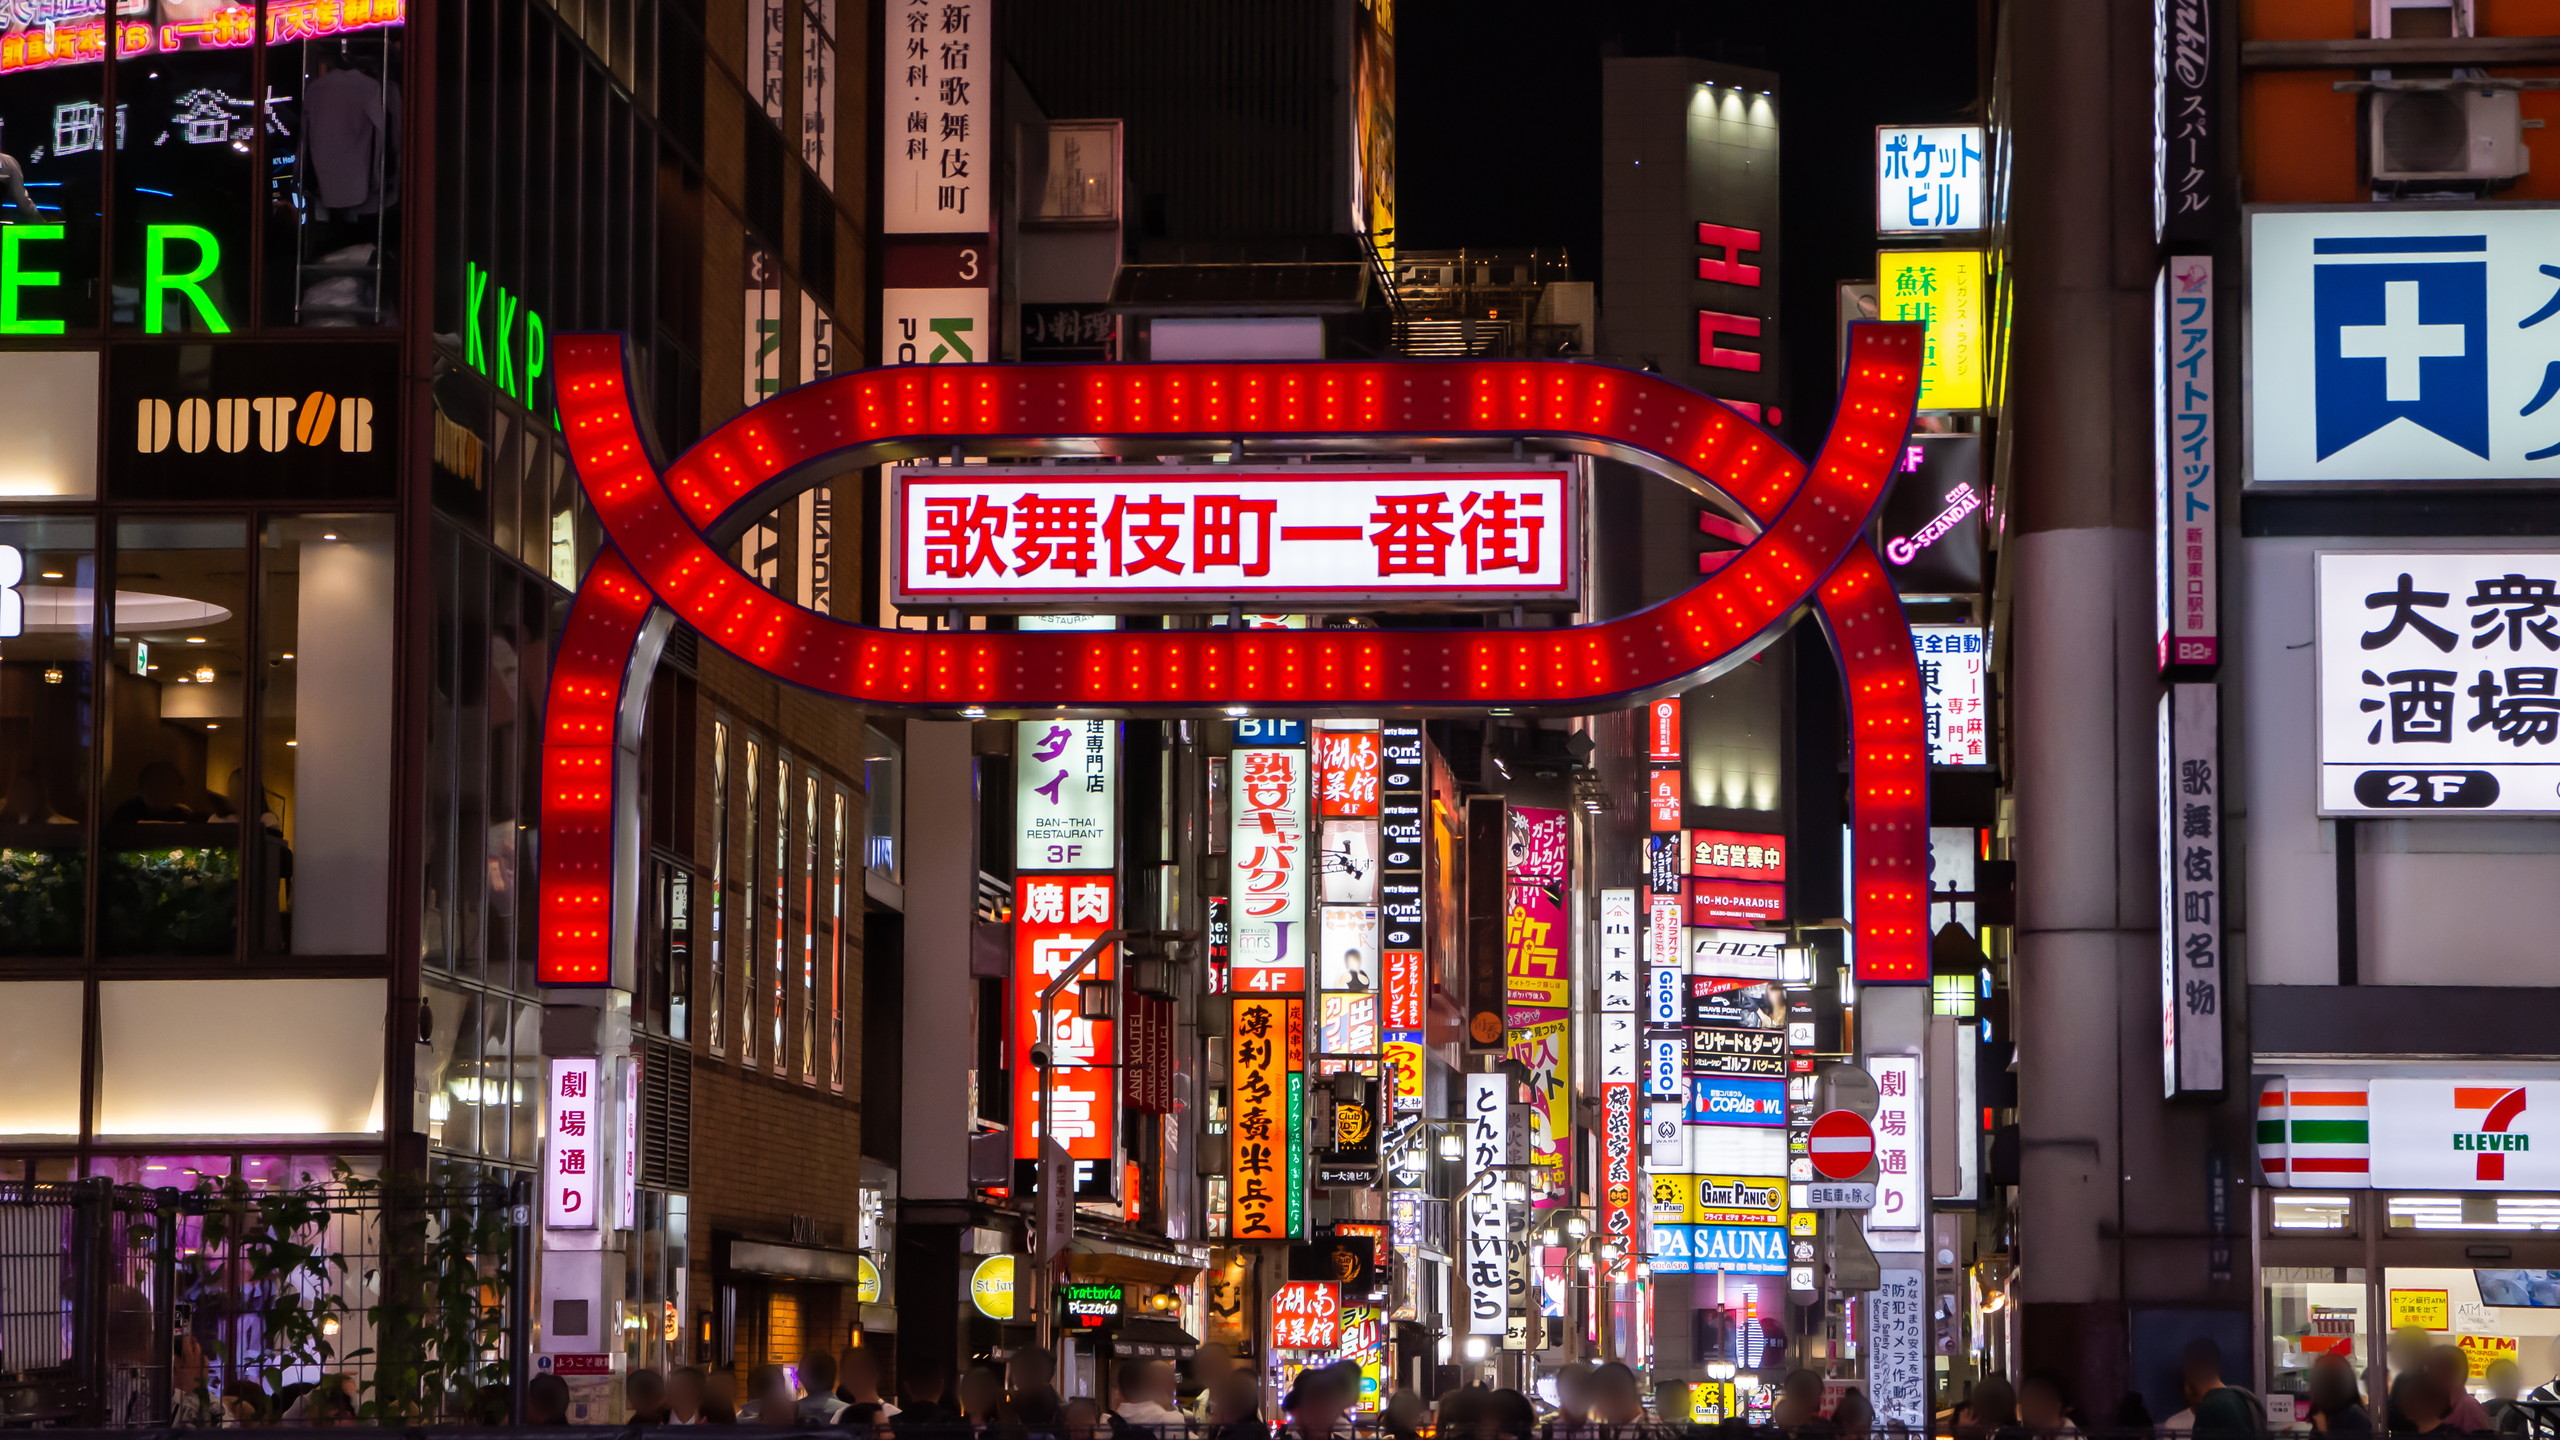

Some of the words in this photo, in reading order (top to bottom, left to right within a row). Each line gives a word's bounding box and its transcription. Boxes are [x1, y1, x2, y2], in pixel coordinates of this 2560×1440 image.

[905, 0, 929, 161] 容外科・歯科
[938, 2, 971, 215] 新宿歌舞伎町
[1884, 132, 1982, 181] ポケット
[2177, 94, 2211, 215] スパークル
[1908, 184, 1960, 228] ビル
[958, 249, 979, 280] 3
[1956, 264, 1968, 376] エレガンス・ラウンジ
[137, 391, 373, 453] DOUTOR
[2175, 297, 2210, 522] ファイトフィット
[1945, 482, 1971, 503] CLUB
[924, 491, 1545, 579] 歌舞伎町一番街
[1886, 493, 1981, 566] G-SCANDAL
[2186, 528, 2204, 630] 新宿東口駅前
[2361, 573, 2560, 653] 大衆
[2179, 643, 2213, 660] B2F
[1966, 658, 1983, 756] リーチ麻雀
[2360, 666, 2560, 747] 酒場
[1032, 725, 1073, 805] タイ
[1323, 736, 1378, 771] 湖南
[1659, 783, 1679, 820] 白木屋
[2387, 775, 2467, 803] 2F
[1036, 818, 1096, 827] BAN-THAI
[1340, 803, 1360, 814] 4F
[1027, 829, 1104, 839] RESTAURANT
[1237, 752, 1301, 917] 熟女キャバクラ
[1047, 845, 1083, 863] 3F
[1695, 841, 1780, 870] 全店営業中
[1022, 883, 1110, 924] 焼肉
[1696, 895, 1780, 909] MO-MO-PARADISE
[2182, 759, 2216, 1016] 歌舞伎町名物
[1668, 916, 1678, 955] カラオケ
[1696, 941, 1778, 958] FACE
[1250, 969, 1287, 990] 4F
[1391, 954, 1405, 1028] リフレッシュ
[1659, 970, 1673, 1018] GiGO
[1289, 1006, 1303, 1062] 炭火串焼
[1326, 996, 1342, 1052] カフェ
[1694, 1031, 1783, 1054] ビリヤード&ダーツ
[1659, 1043, 1673, 1091] GiGO
[1721, 1055, 1751, 1072] ゴルフ
[1752, 1059, 1783, 1072] バグース
[559, 1070, 588, 1214] 劇場通り
[1607, 1086, 1631, 1183] 横浜家系
[1879, 1070, 1907, 1214] 劇場通り
[1321, 1171, 1372, 1181] 第一大滝ビル
[1702, 1181, 1732, 1204] GAME
[1734, 1182, 1766, 1206] PANIC
[1812, 1188, 1870, 1203] 自転車を除く
[1742, 1214, 1765, 1222] アーケード
[1694, 1229, 1786, 1259] SAUNA
[1276, 1282, 1335, 1317] 湖南
[1882, 1283, 1890, 1297] For
[2393, 1296, 2446, 1304] セブン銀行ATM
[1872, 1298, 1881, 1333] Security
[1882, 1301, 1890, 1320] Your
[1873, 1336, 1881, 1369] Camera
[1881, 1323, 1890, 1350] Safety
[1892, 1283, 1905, 1417] 防犯カメラ作動中
[1907, 1276, 1920, 1425] みなさまの安全を守ります
[2458, 1336, 2517, 1351] ATM
